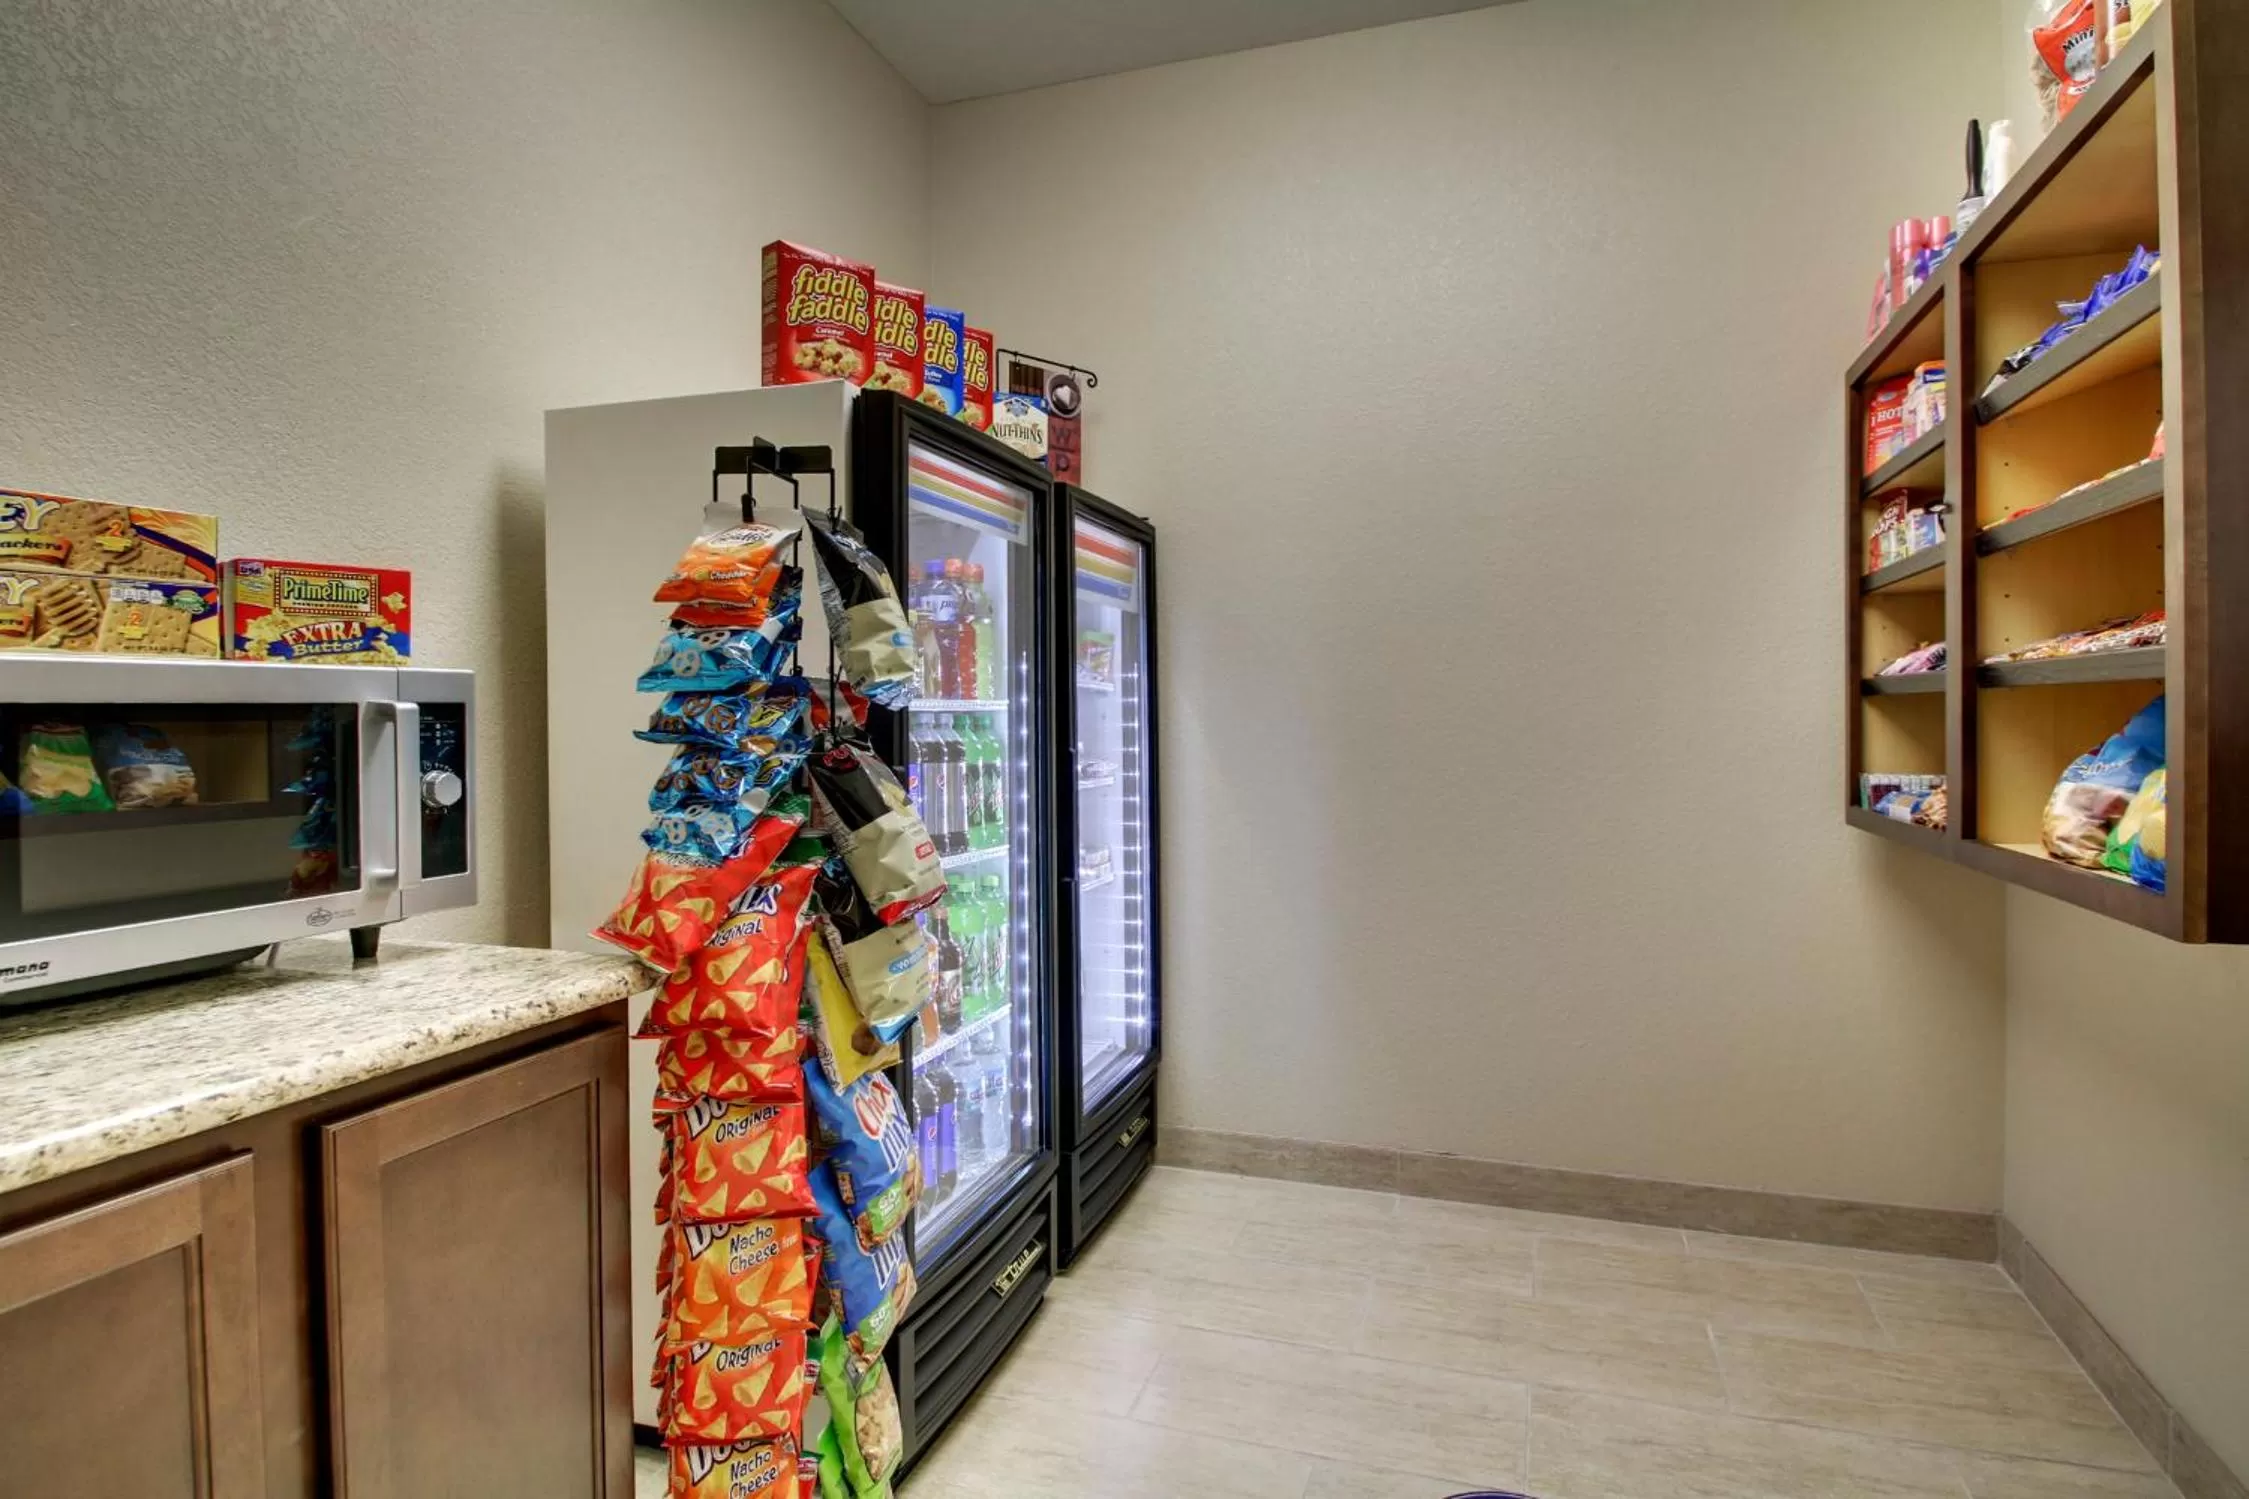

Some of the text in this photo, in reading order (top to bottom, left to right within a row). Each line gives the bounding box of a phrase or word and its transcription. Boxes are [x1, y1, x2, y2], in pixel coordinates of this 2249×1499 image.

[795, 265, 867, 309] fiddle
[788, 293, 868, 333] faddle
[284, 576, 369, 604] PrimeTime
[283, 621, 363, 646] EXTRA
[292, 639, 364, 657] Butter
[0, 961, 49, 977] mana
[730, 1225, 773, 1253] Nacho
[729, 1242, 779, 1275] Cheese
[730, 1450, 773, 1478] Nacho
